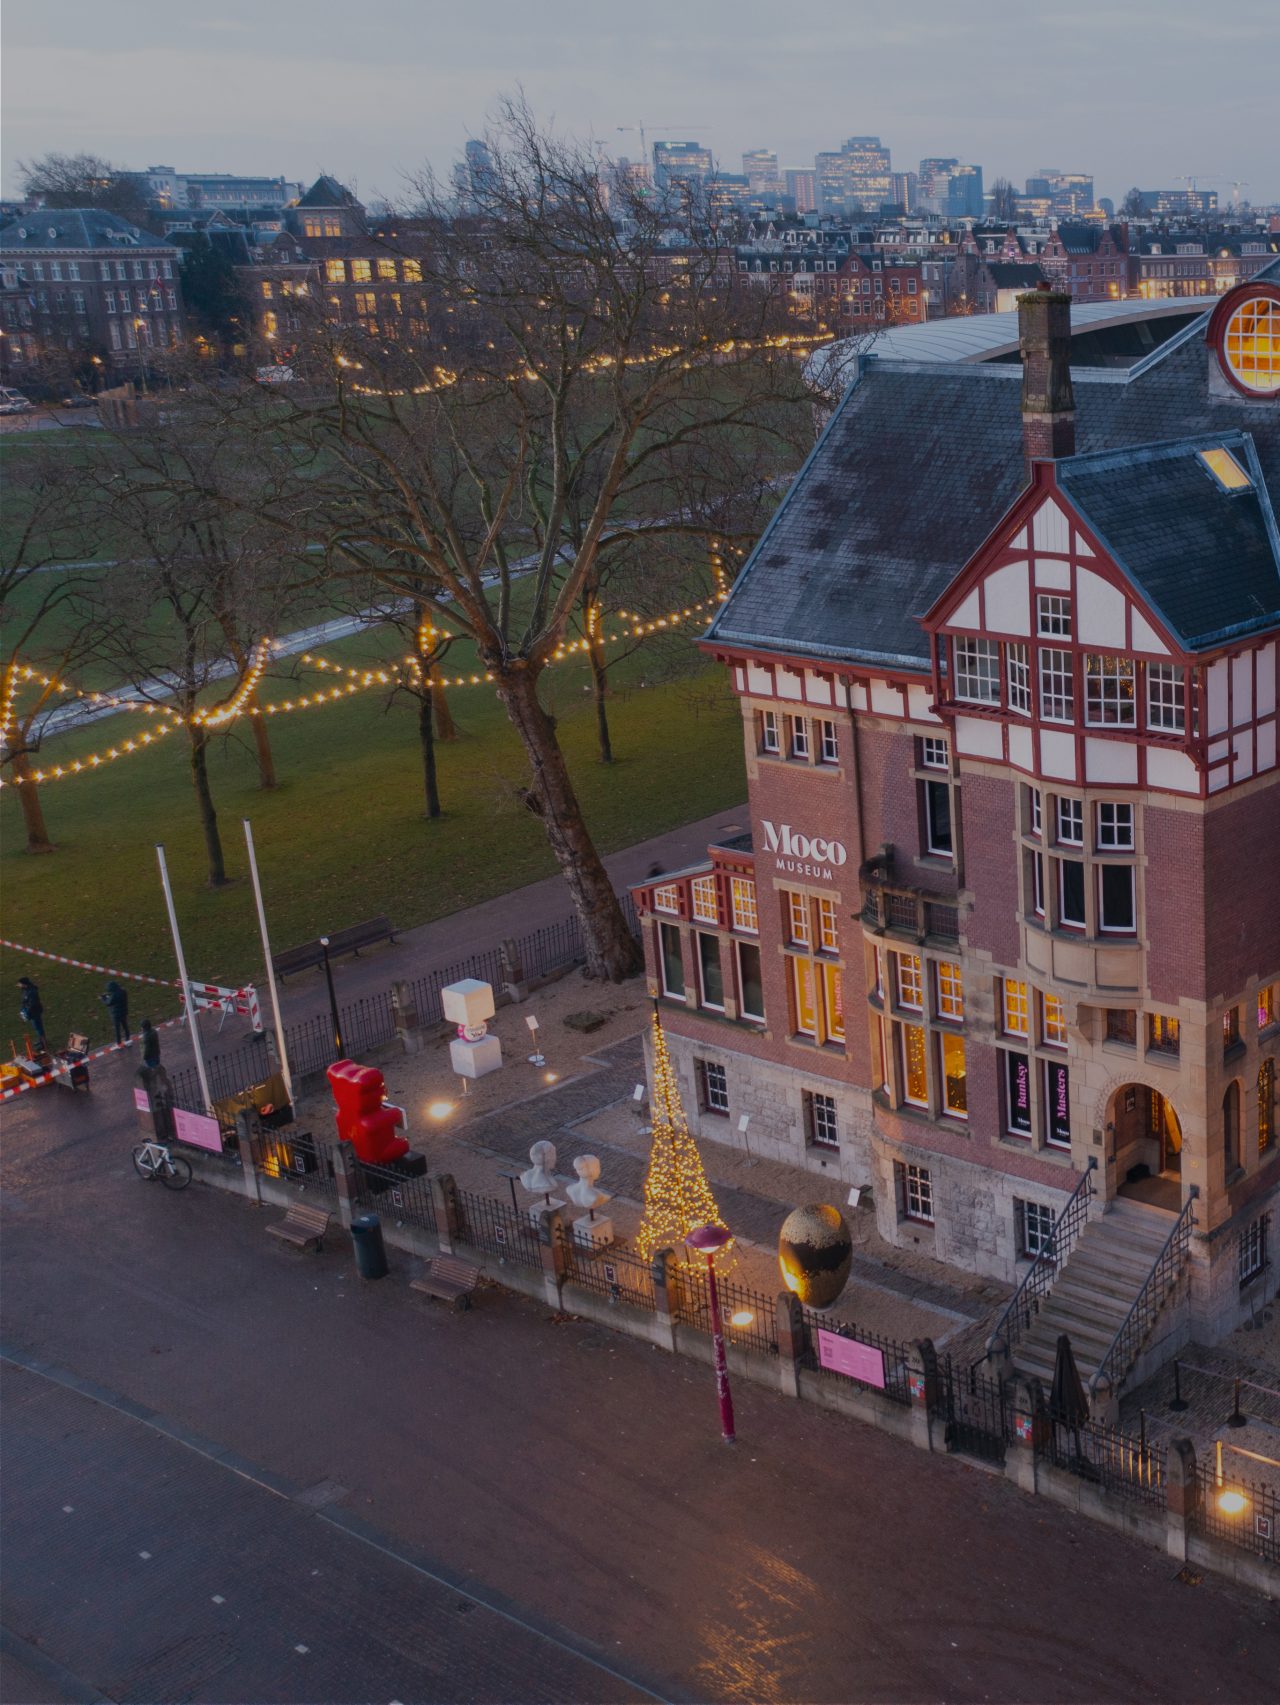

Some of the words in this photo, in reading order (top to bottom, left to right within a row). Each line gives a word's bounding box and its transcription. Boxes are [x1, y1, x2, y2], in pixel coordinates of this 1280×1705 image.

[760, 820, 846, 866] Moco
[776, 858, 832, 880] MUSEUM
[1016, 1061, 1028, 1109] Banksy
[1057, 1068, 1067, 1120] Masters
